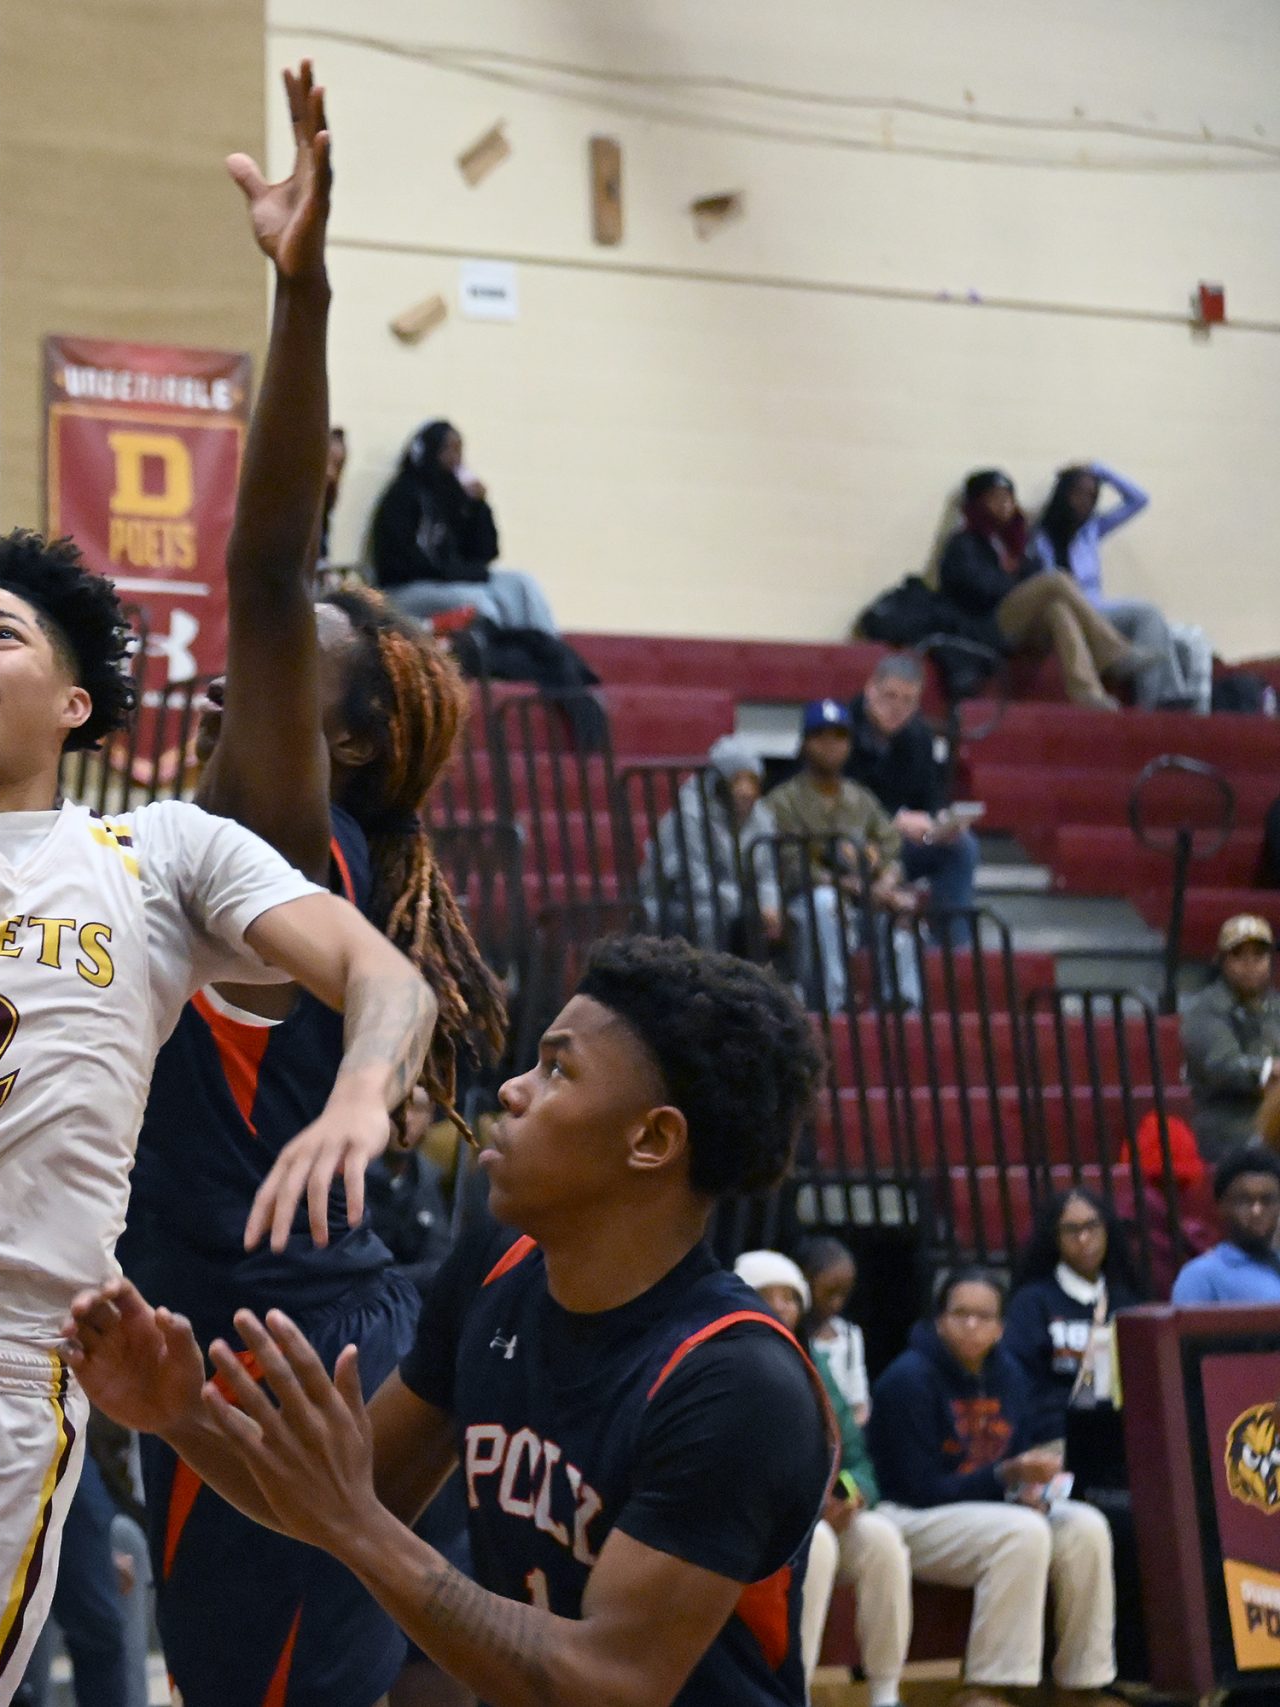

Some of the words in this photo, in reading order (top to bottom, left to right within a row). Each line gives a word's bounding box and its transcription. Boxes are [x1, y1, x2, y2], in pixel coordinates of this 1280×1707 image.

[108, 431, 193, 517] D
[108, 518, 198, 570] POETS
[464, 1423, 603, 1566] POLY
